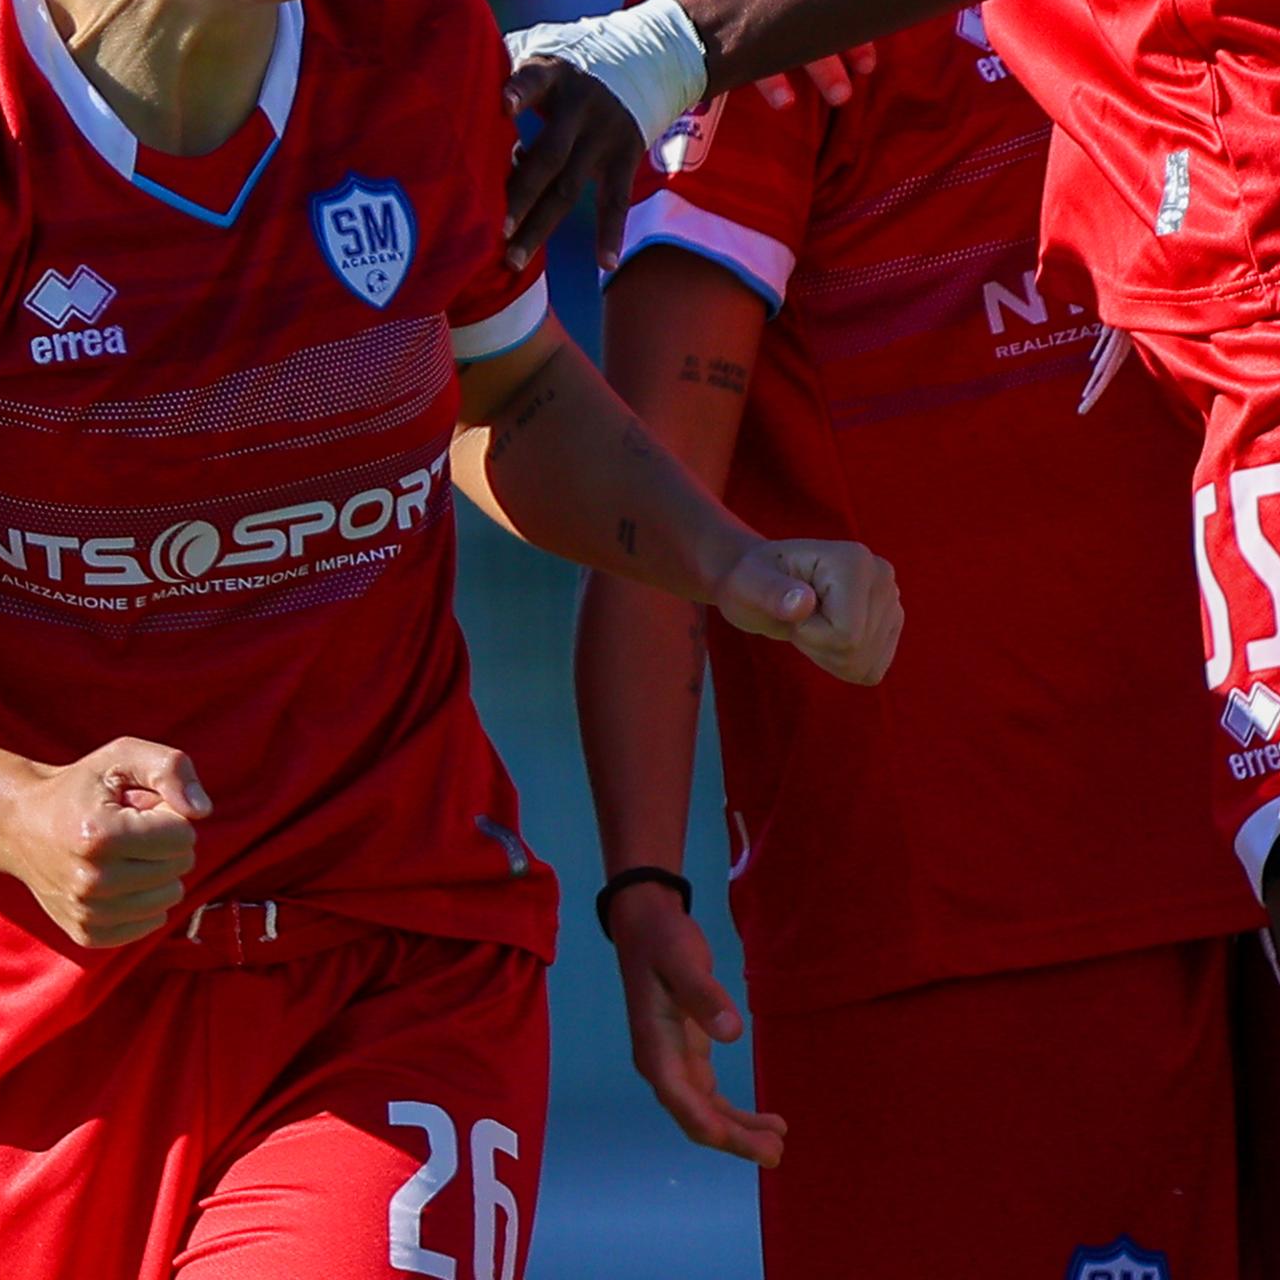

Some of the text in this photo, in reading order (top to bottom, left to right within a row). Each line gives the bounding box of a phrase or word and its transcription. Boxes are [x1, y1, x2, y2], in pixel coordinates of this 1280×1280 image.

[330, 202, 400, 257] SM
[342, 252, 404, 270] ACADEMY
[136, 596, 147, 608] E
[152, 564, 310, 602] MANUTENZIONE
[315, 544, 402, 573] IMPIANTI
[388, 1100, 519, 1280] 26
